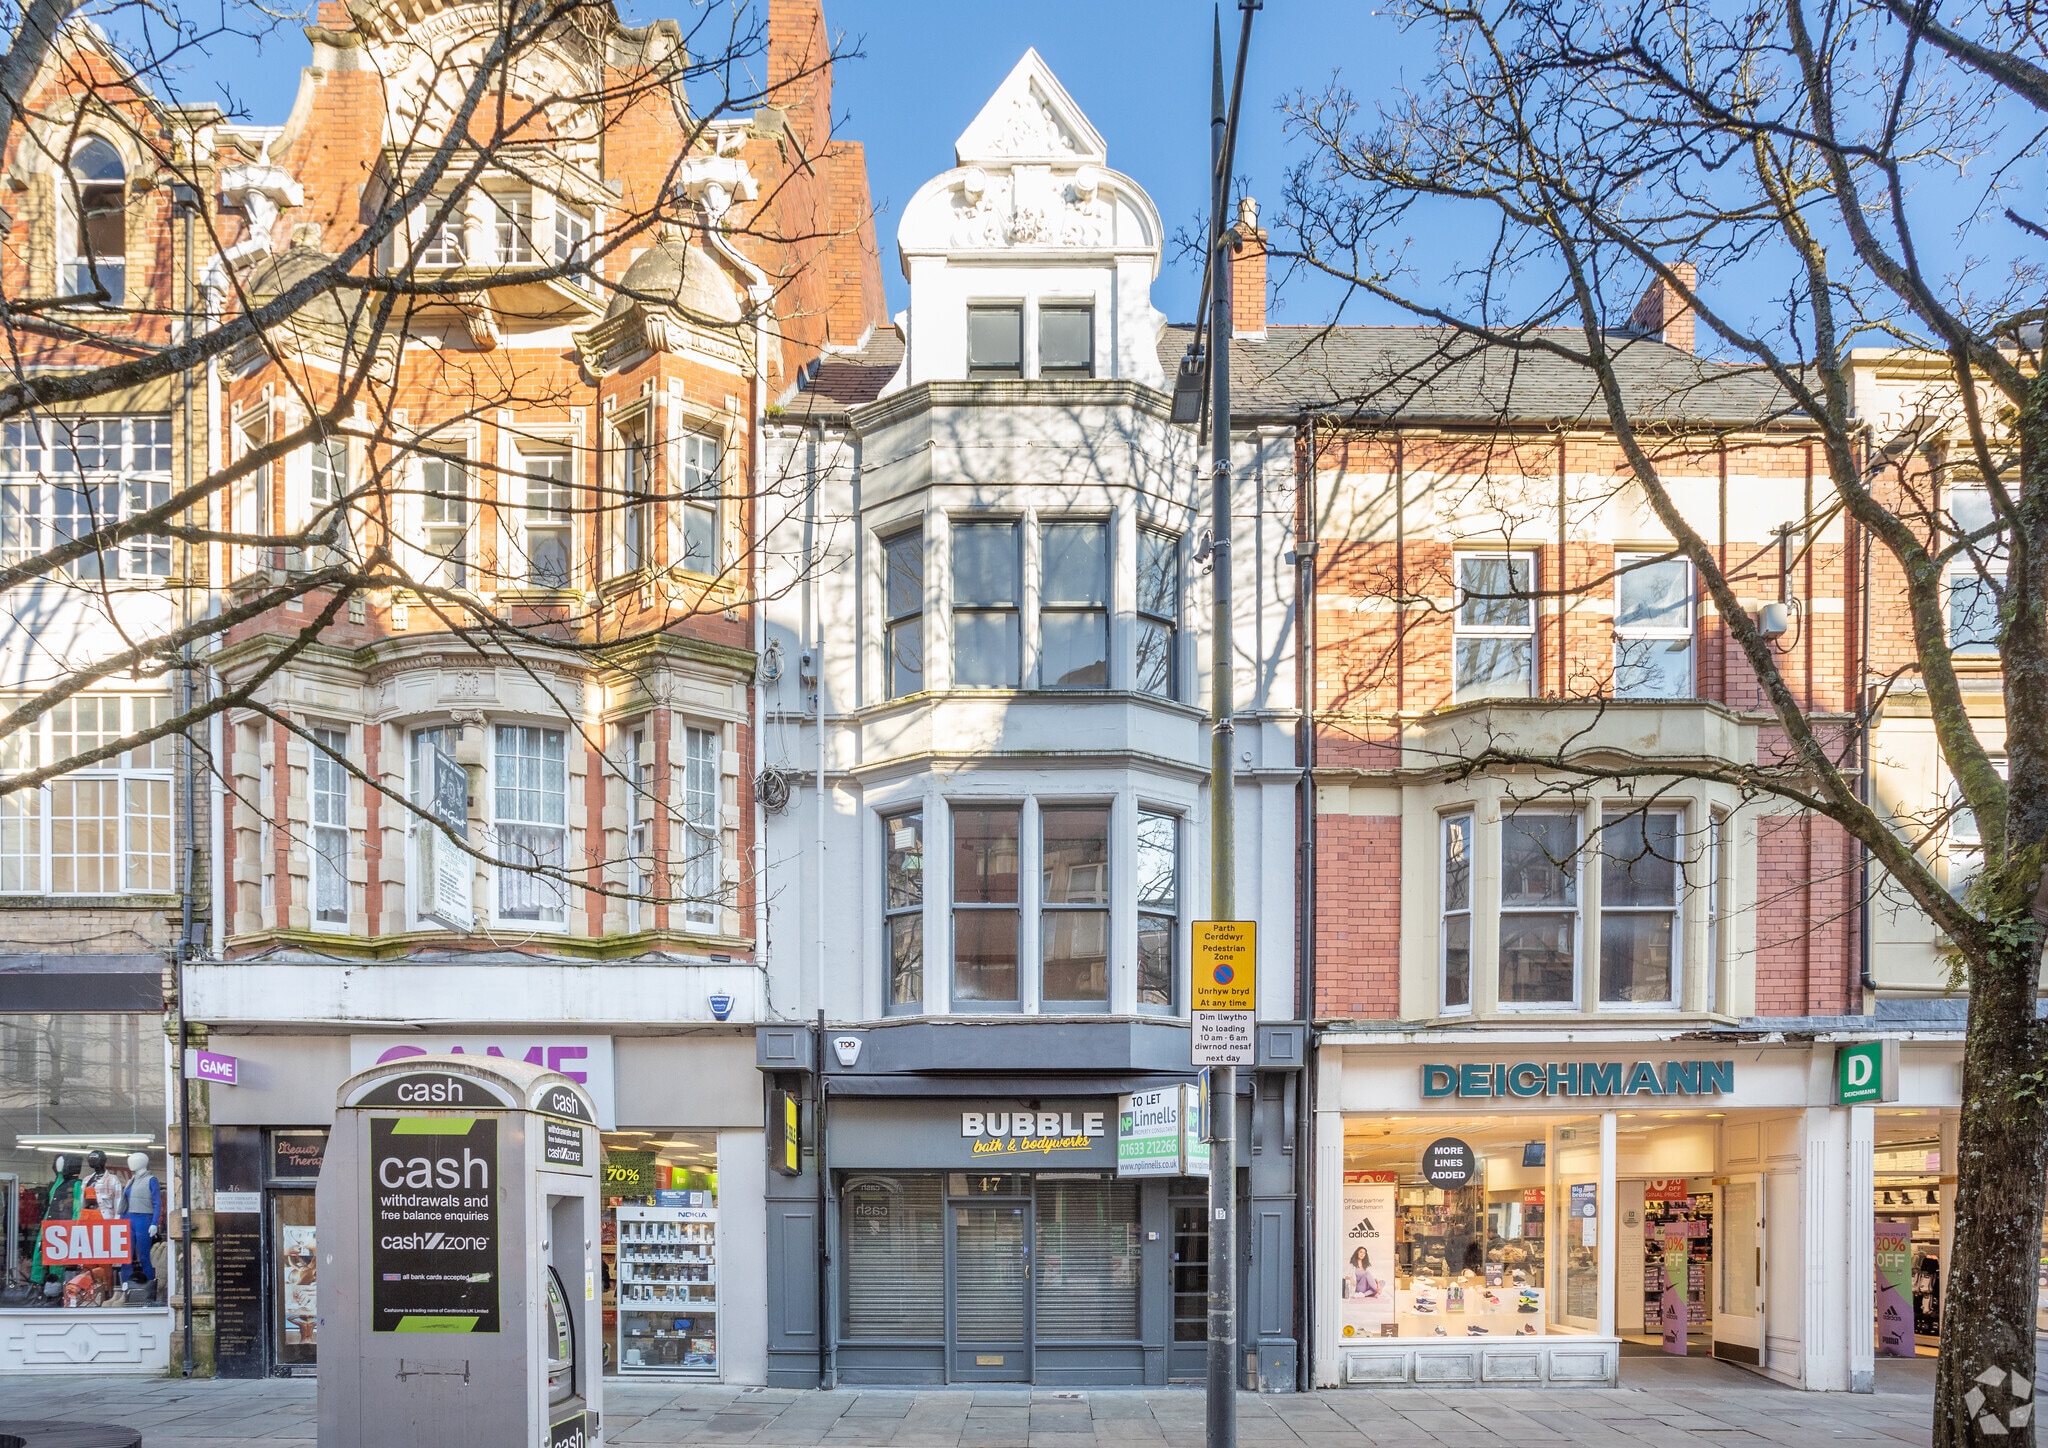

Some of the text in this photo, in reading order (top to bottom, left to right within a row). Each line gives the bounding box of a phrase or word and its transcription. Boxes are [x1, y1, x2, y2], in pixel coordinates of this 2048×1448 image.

[1204, 933, 1244, 941] Cerddwyr
[1198, 987, 1250, 996] Unrhyw bryd
[1218, 1014, 1248, 1022] llwytho
[1216, 1025, 1245, 1034] loading
[1227, 1054, 1240, 1062] day
[200, 1059, 233, 1077] GAME
[1848, 1054, 1872, 1086] D
[1420, 1061, 1735, 1098] DEICHMANN
[398, 1078, 463, 1102] cash
[1844, 1088, 1876, 1098] DEICHMANN
[553, 1093, 578, 1114] cash
[1132, 1094, 1161, 1107] TO LET
[1134, 1106, 1176, 1126] Linnells
[548, 1125, 572, 1136] withdrawals
[961, 1112, 1104, 1137] BUBBLE
[1121, 1116, 1132, 1132] NP
[282, 1142, 319, 1156] Beauty
[973, 1134, 1091, 1154] bath & bodyworks
[1120, 1140, 1177, 1156] 01633 212266
[290, 1155, 324, 1169] Therap
[380, 1148, 488, 1189] cash
[1120, 1159, 1177, 1172] www.nplinnells.co.uk
[607, 1169, 640, 1181] 70%
[978, 1177, 1000, 1192] 47
[381, 1194, 488, 1207] withdrawals and
[381, 1210, 489, 1222] free balance enquiries
[45, 1225, 129, 1260] SALE
[1876, 1237, 1906, 1252] 20%
[1666, 1253, 1683, 1266] OFF
[1876, 1254, 1905, 1267] OFF
[1882, 1336, 1899, 1345] PUMA
